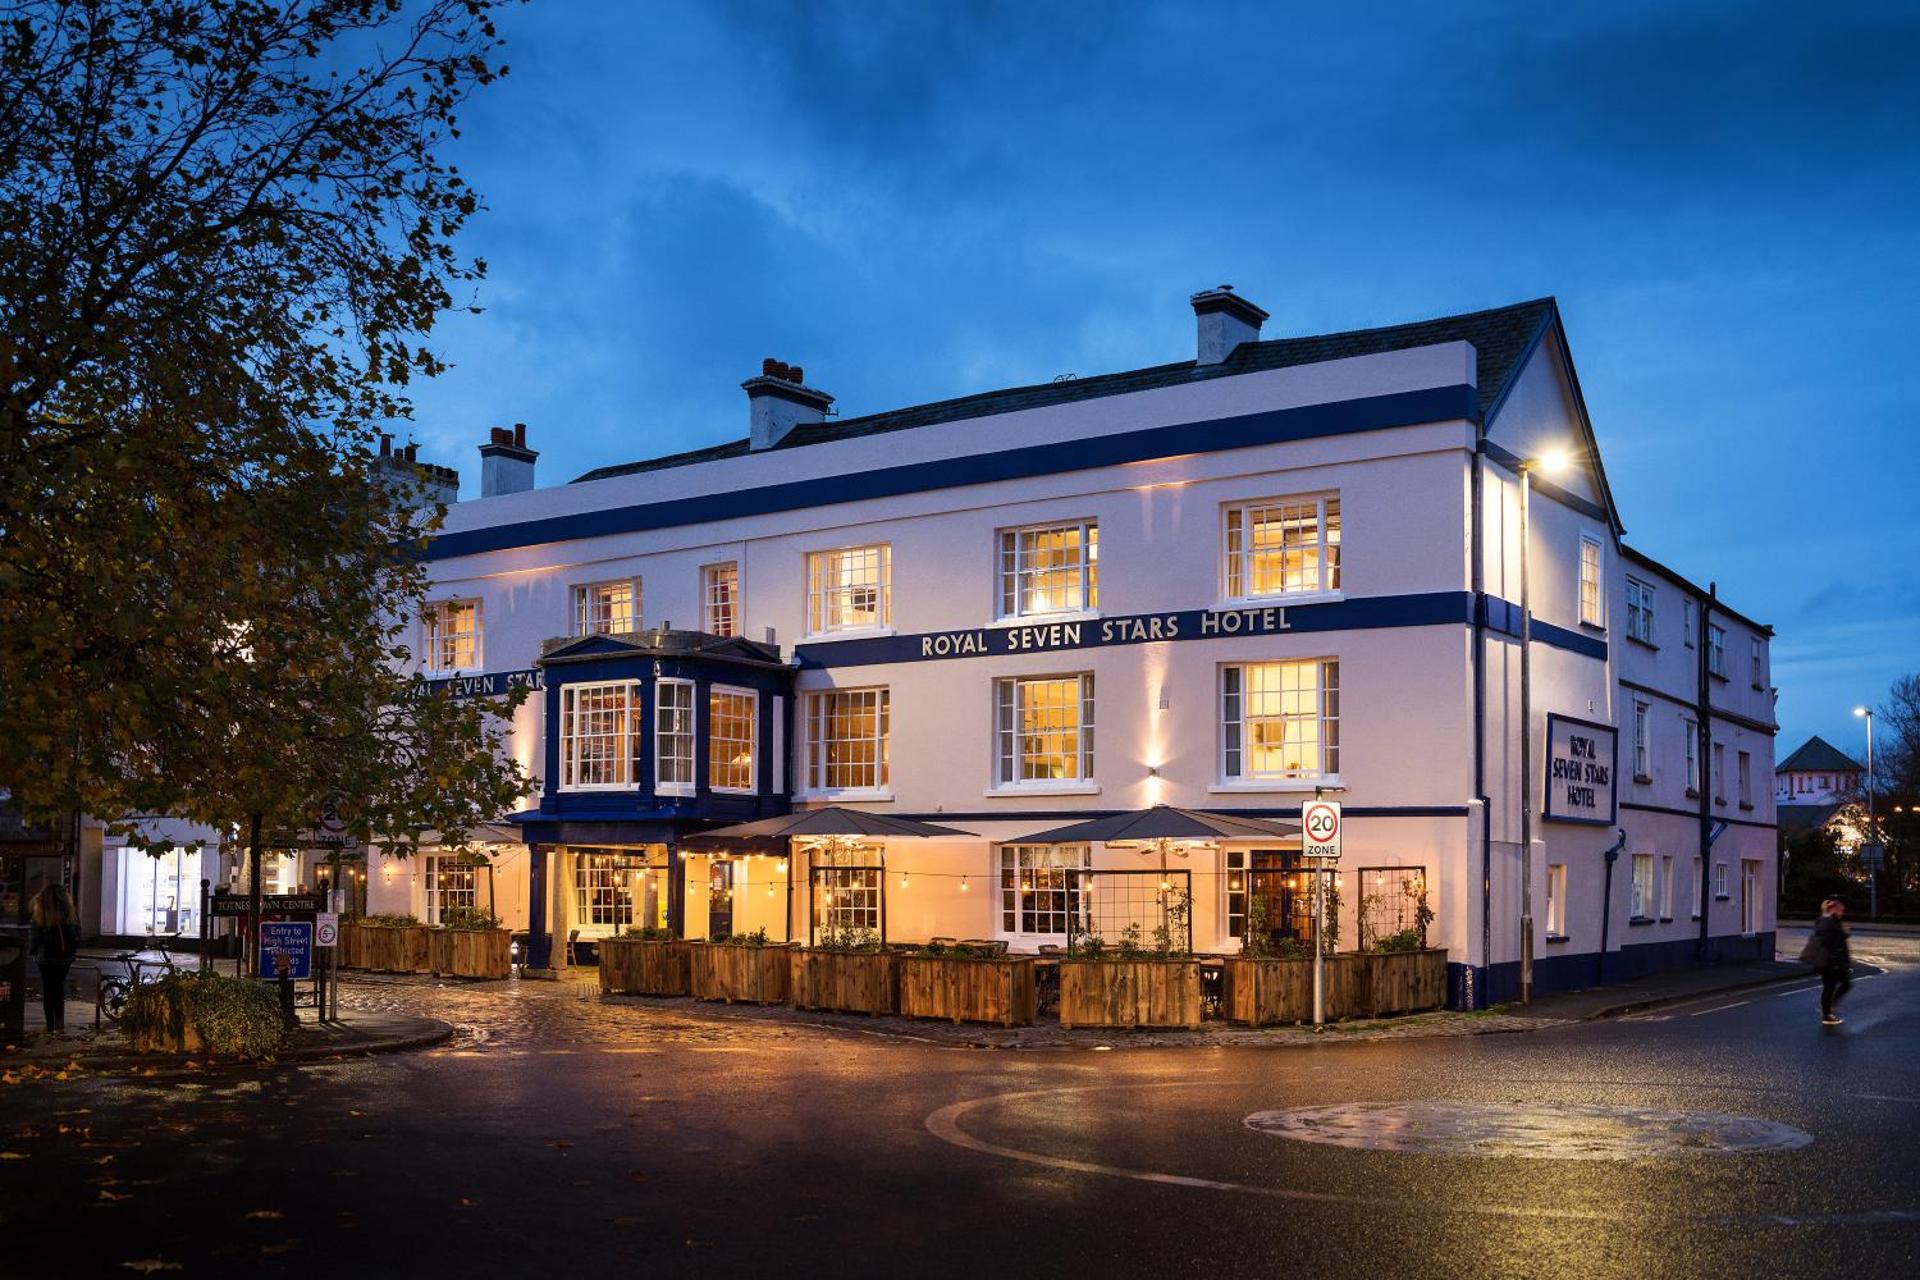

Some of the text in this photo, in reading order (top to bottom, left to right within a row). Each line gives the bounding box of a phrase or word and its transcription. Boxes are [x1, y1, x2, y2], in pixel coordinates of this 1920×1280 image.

[922, 607, 1291, 656] ROYAL SEVEN STARS HOTEL
[1570, 734, 1596, 759] ROYAL
[1553, 757, 1609, 785] SEVEN STARS
[1568, 785, 1596, 808] HOTEL
[1311, 815, 1335, 832] 20
[1308, 845, 1336, 855] ZONE
[217, 901, 250, 911] TOTNES
[283, 901, 316, 910] CENTRE
[270, 927, 302, 936] Entry to
[264, 936, 309, 947] High Street
